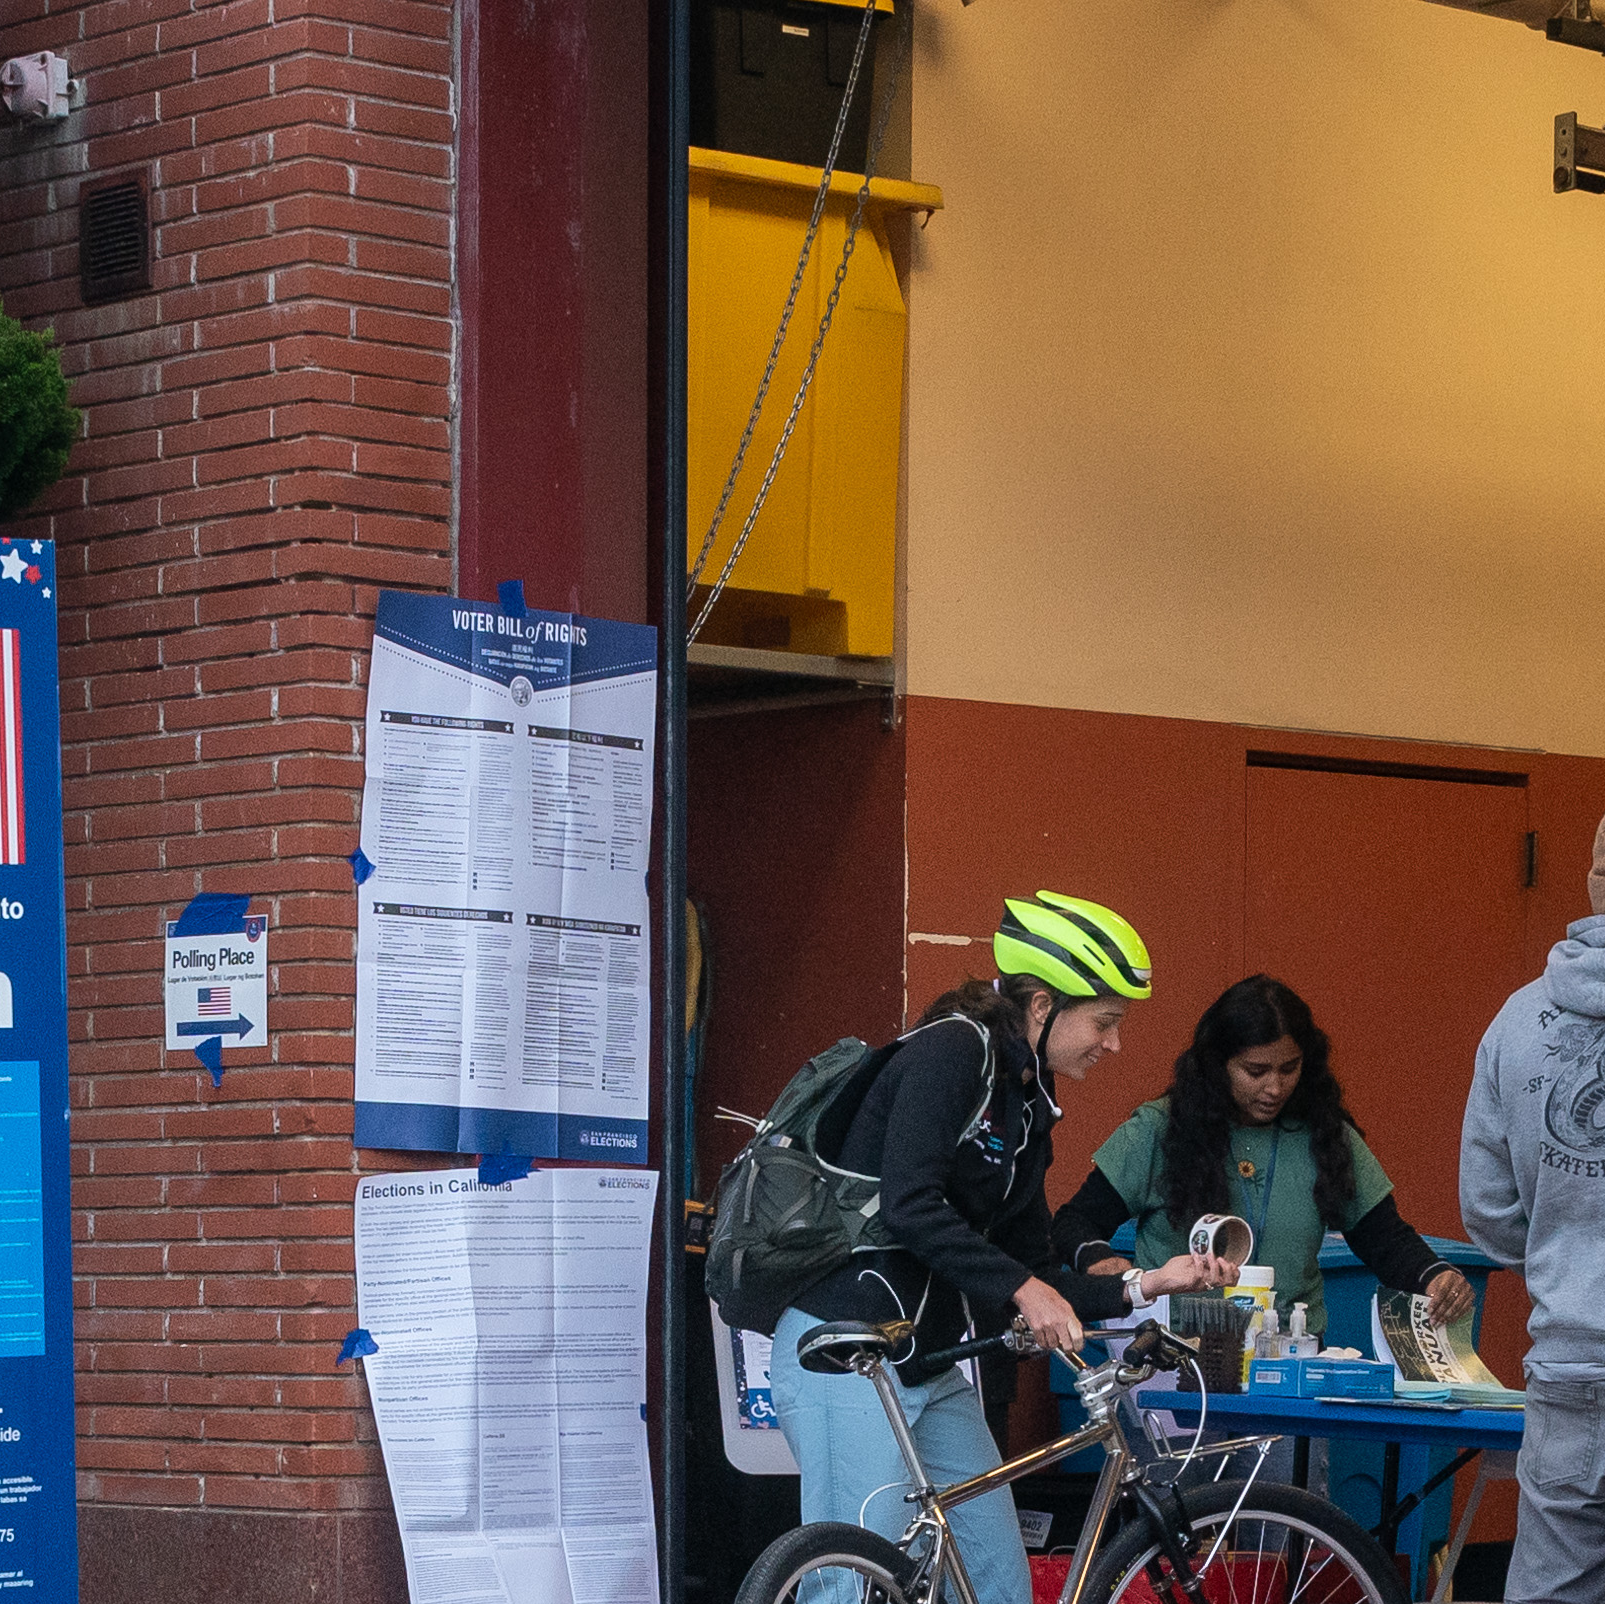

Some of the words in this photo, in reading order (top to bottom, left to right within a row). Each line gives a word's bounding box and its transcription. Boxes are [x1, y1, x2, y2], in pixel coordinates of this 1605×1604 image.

[452, 609, 494, 633] VOTER
[497, 615, 524, 637] BILL
[525, 621, 545, 643] of
[545, 622, 587, 647] RIGHTS
[172, 949, 216, 971] Polling
[219, 947, 254, 966] Place
[590, 1136, 638, 1148] ELECTIONS
[362, 1183, 424, 1199] Elections
[429, 1181, 443, 1195] in
